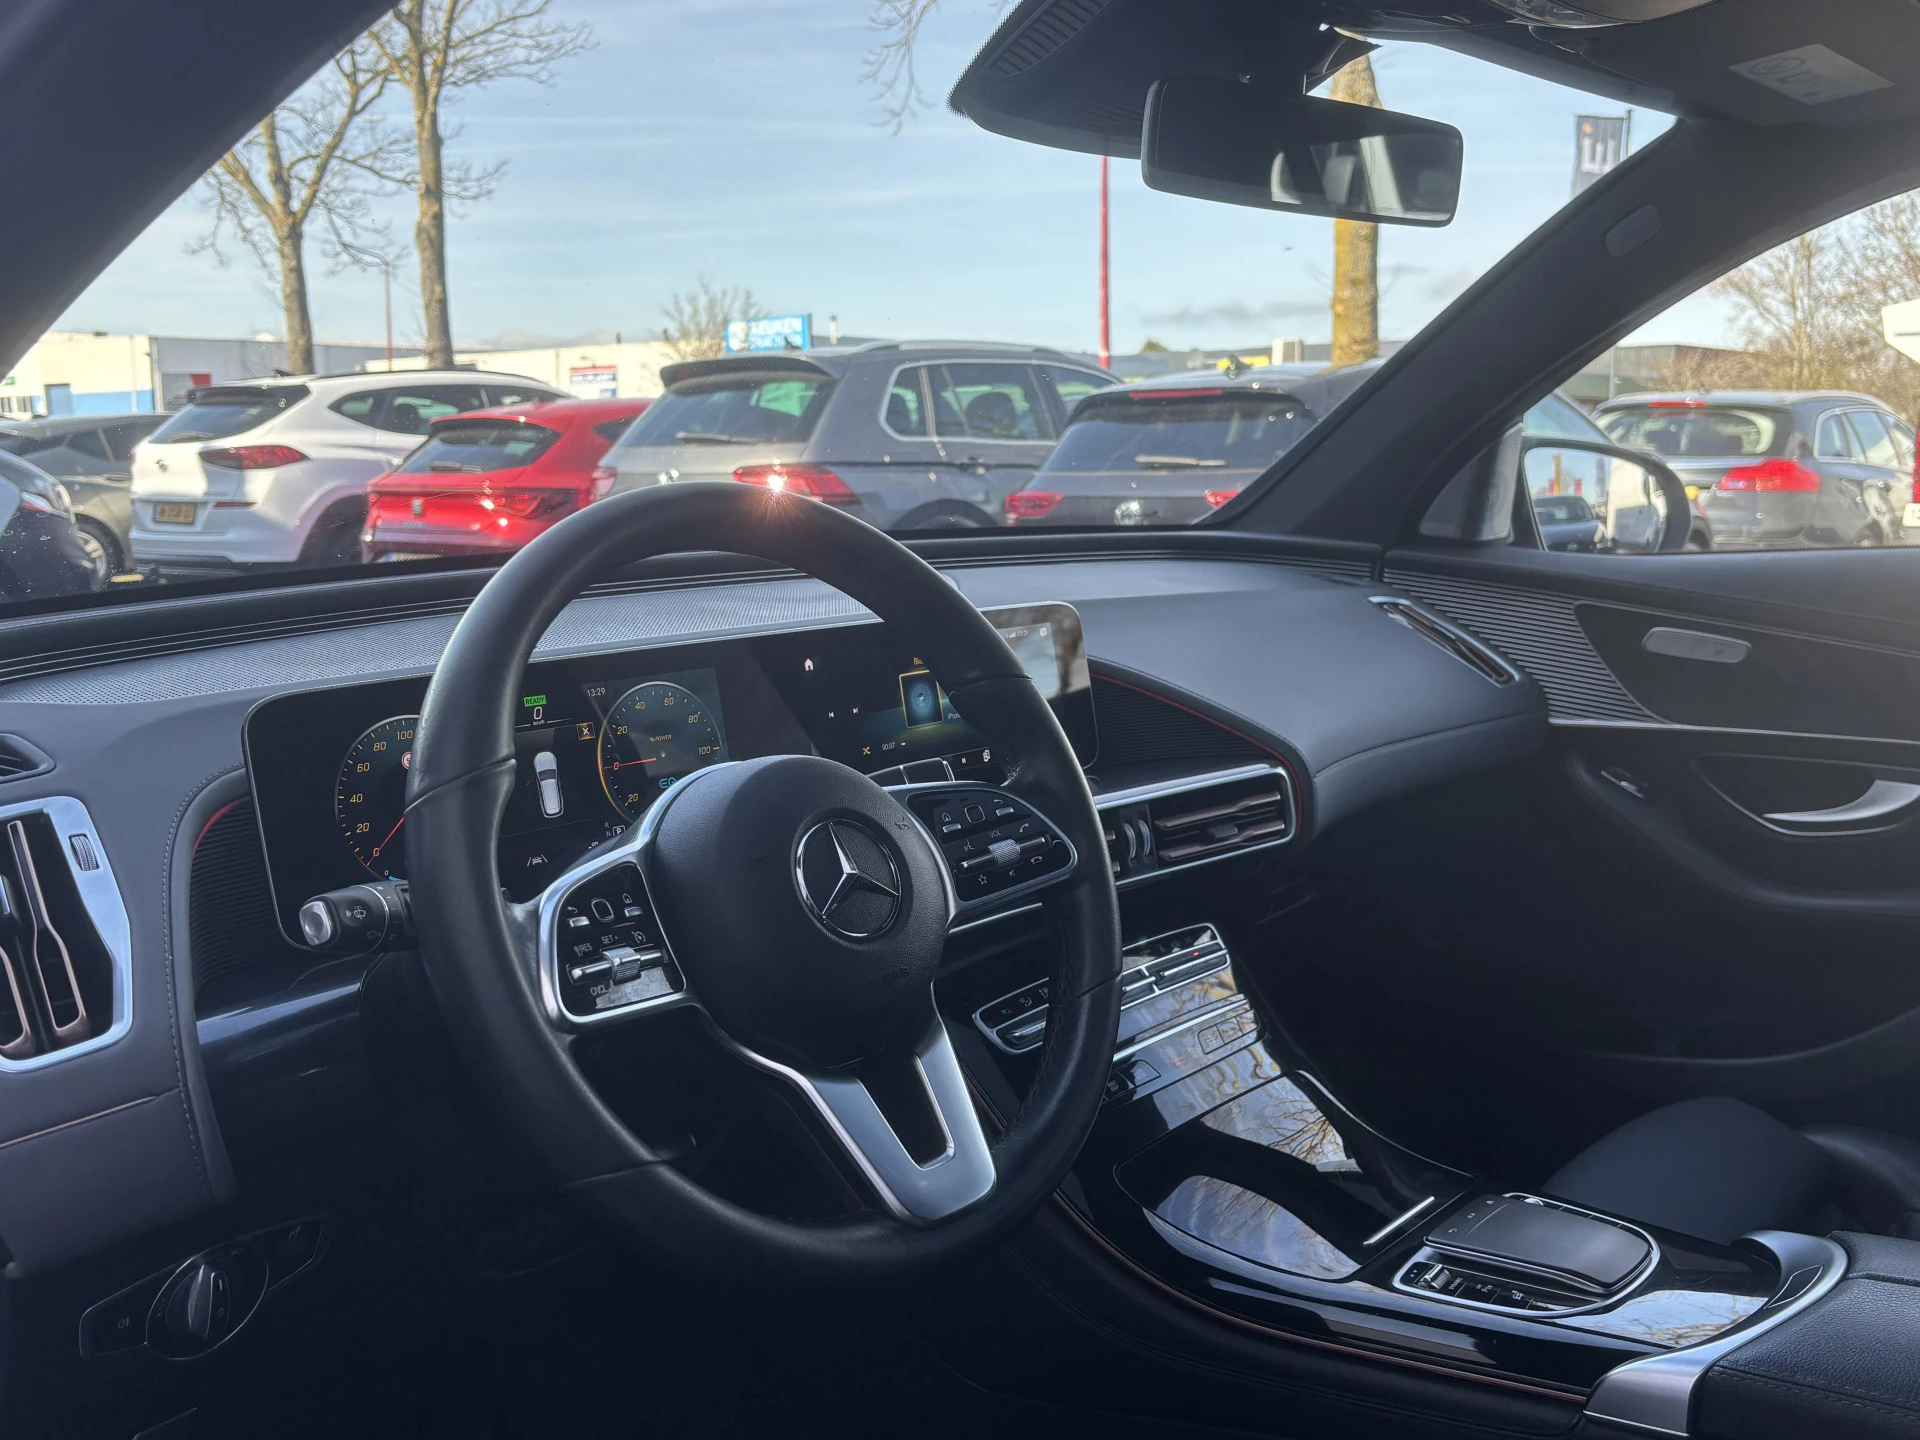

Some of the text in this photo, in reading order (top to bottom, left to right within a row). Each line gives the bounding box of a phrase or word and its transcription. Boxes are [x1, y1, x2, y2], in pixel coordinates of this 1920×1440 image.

[587, 687, 606, 697] 13:29
[525, 696, 545, 705] READY
[635, 701, 645, 710] 40
[664, 697, 674, 706] 60
[533, 706, 543, 720] 0
[688, 714, 699, 724] 80
[396, 730, 413, 740] 100
[617, 725, 628, 735] 20
[373, 742, 387, 752] 80
[698, 745, 711, 755] 100
[357, 762, 370, 773] 60
[613, 761, 620, 771] 0
[350, 793, 363, 803] 40
[628, 793, 639, 803] 20
[356, 822, 370, 833] 20
[987, 829, 1002, 838] VOL
[373, 847, 380, 857] 0
